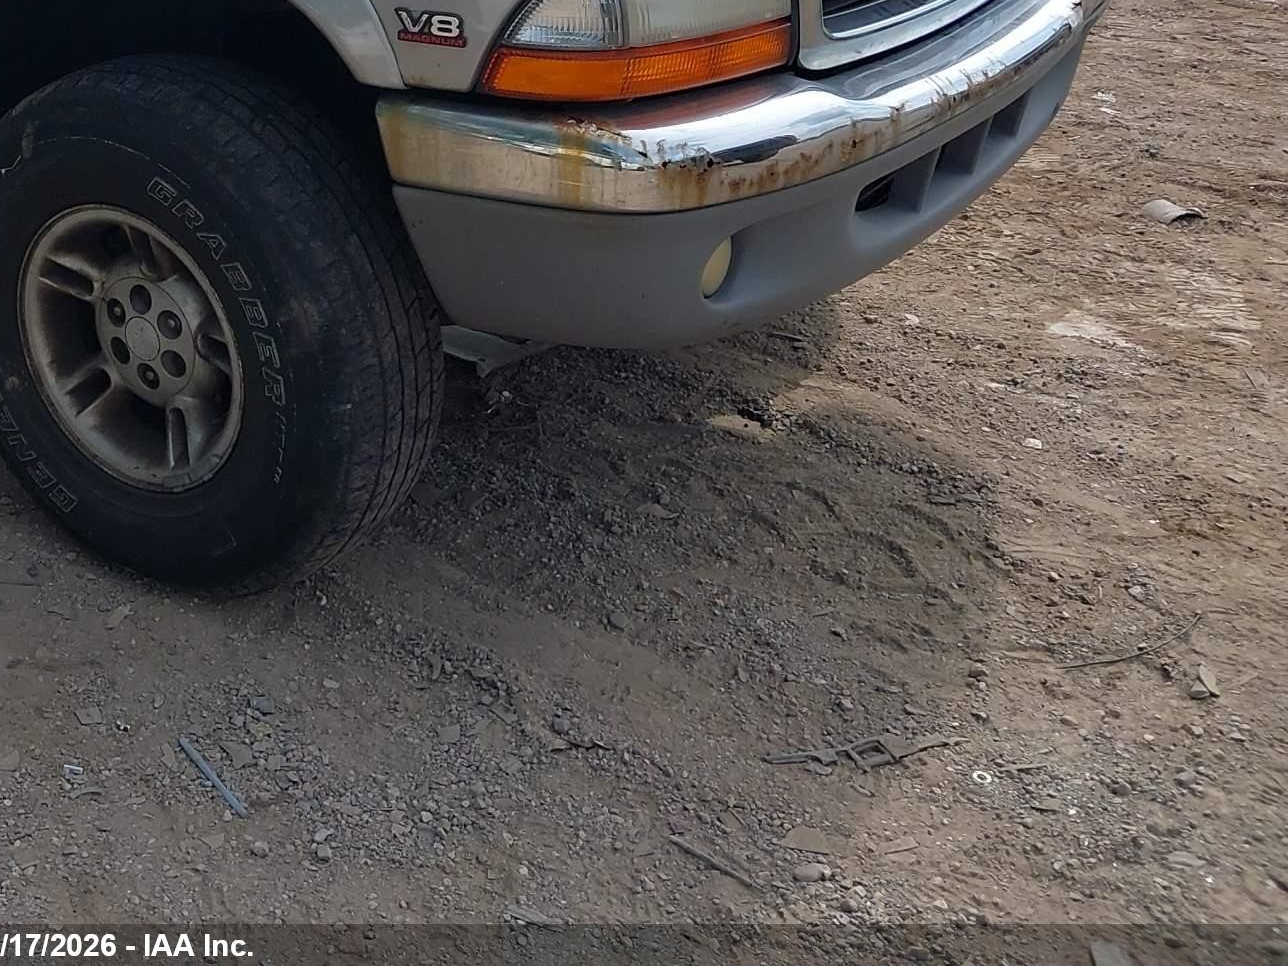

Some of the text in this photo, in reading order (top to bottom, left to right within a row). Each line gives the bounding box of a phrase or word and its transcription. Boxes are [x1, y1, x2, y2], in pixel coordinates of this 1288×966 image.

[396, 9, 462, 38] V8
[399, 32, 465, 47] MAGNUM
[146, 176, 286, 405] GRABBER
